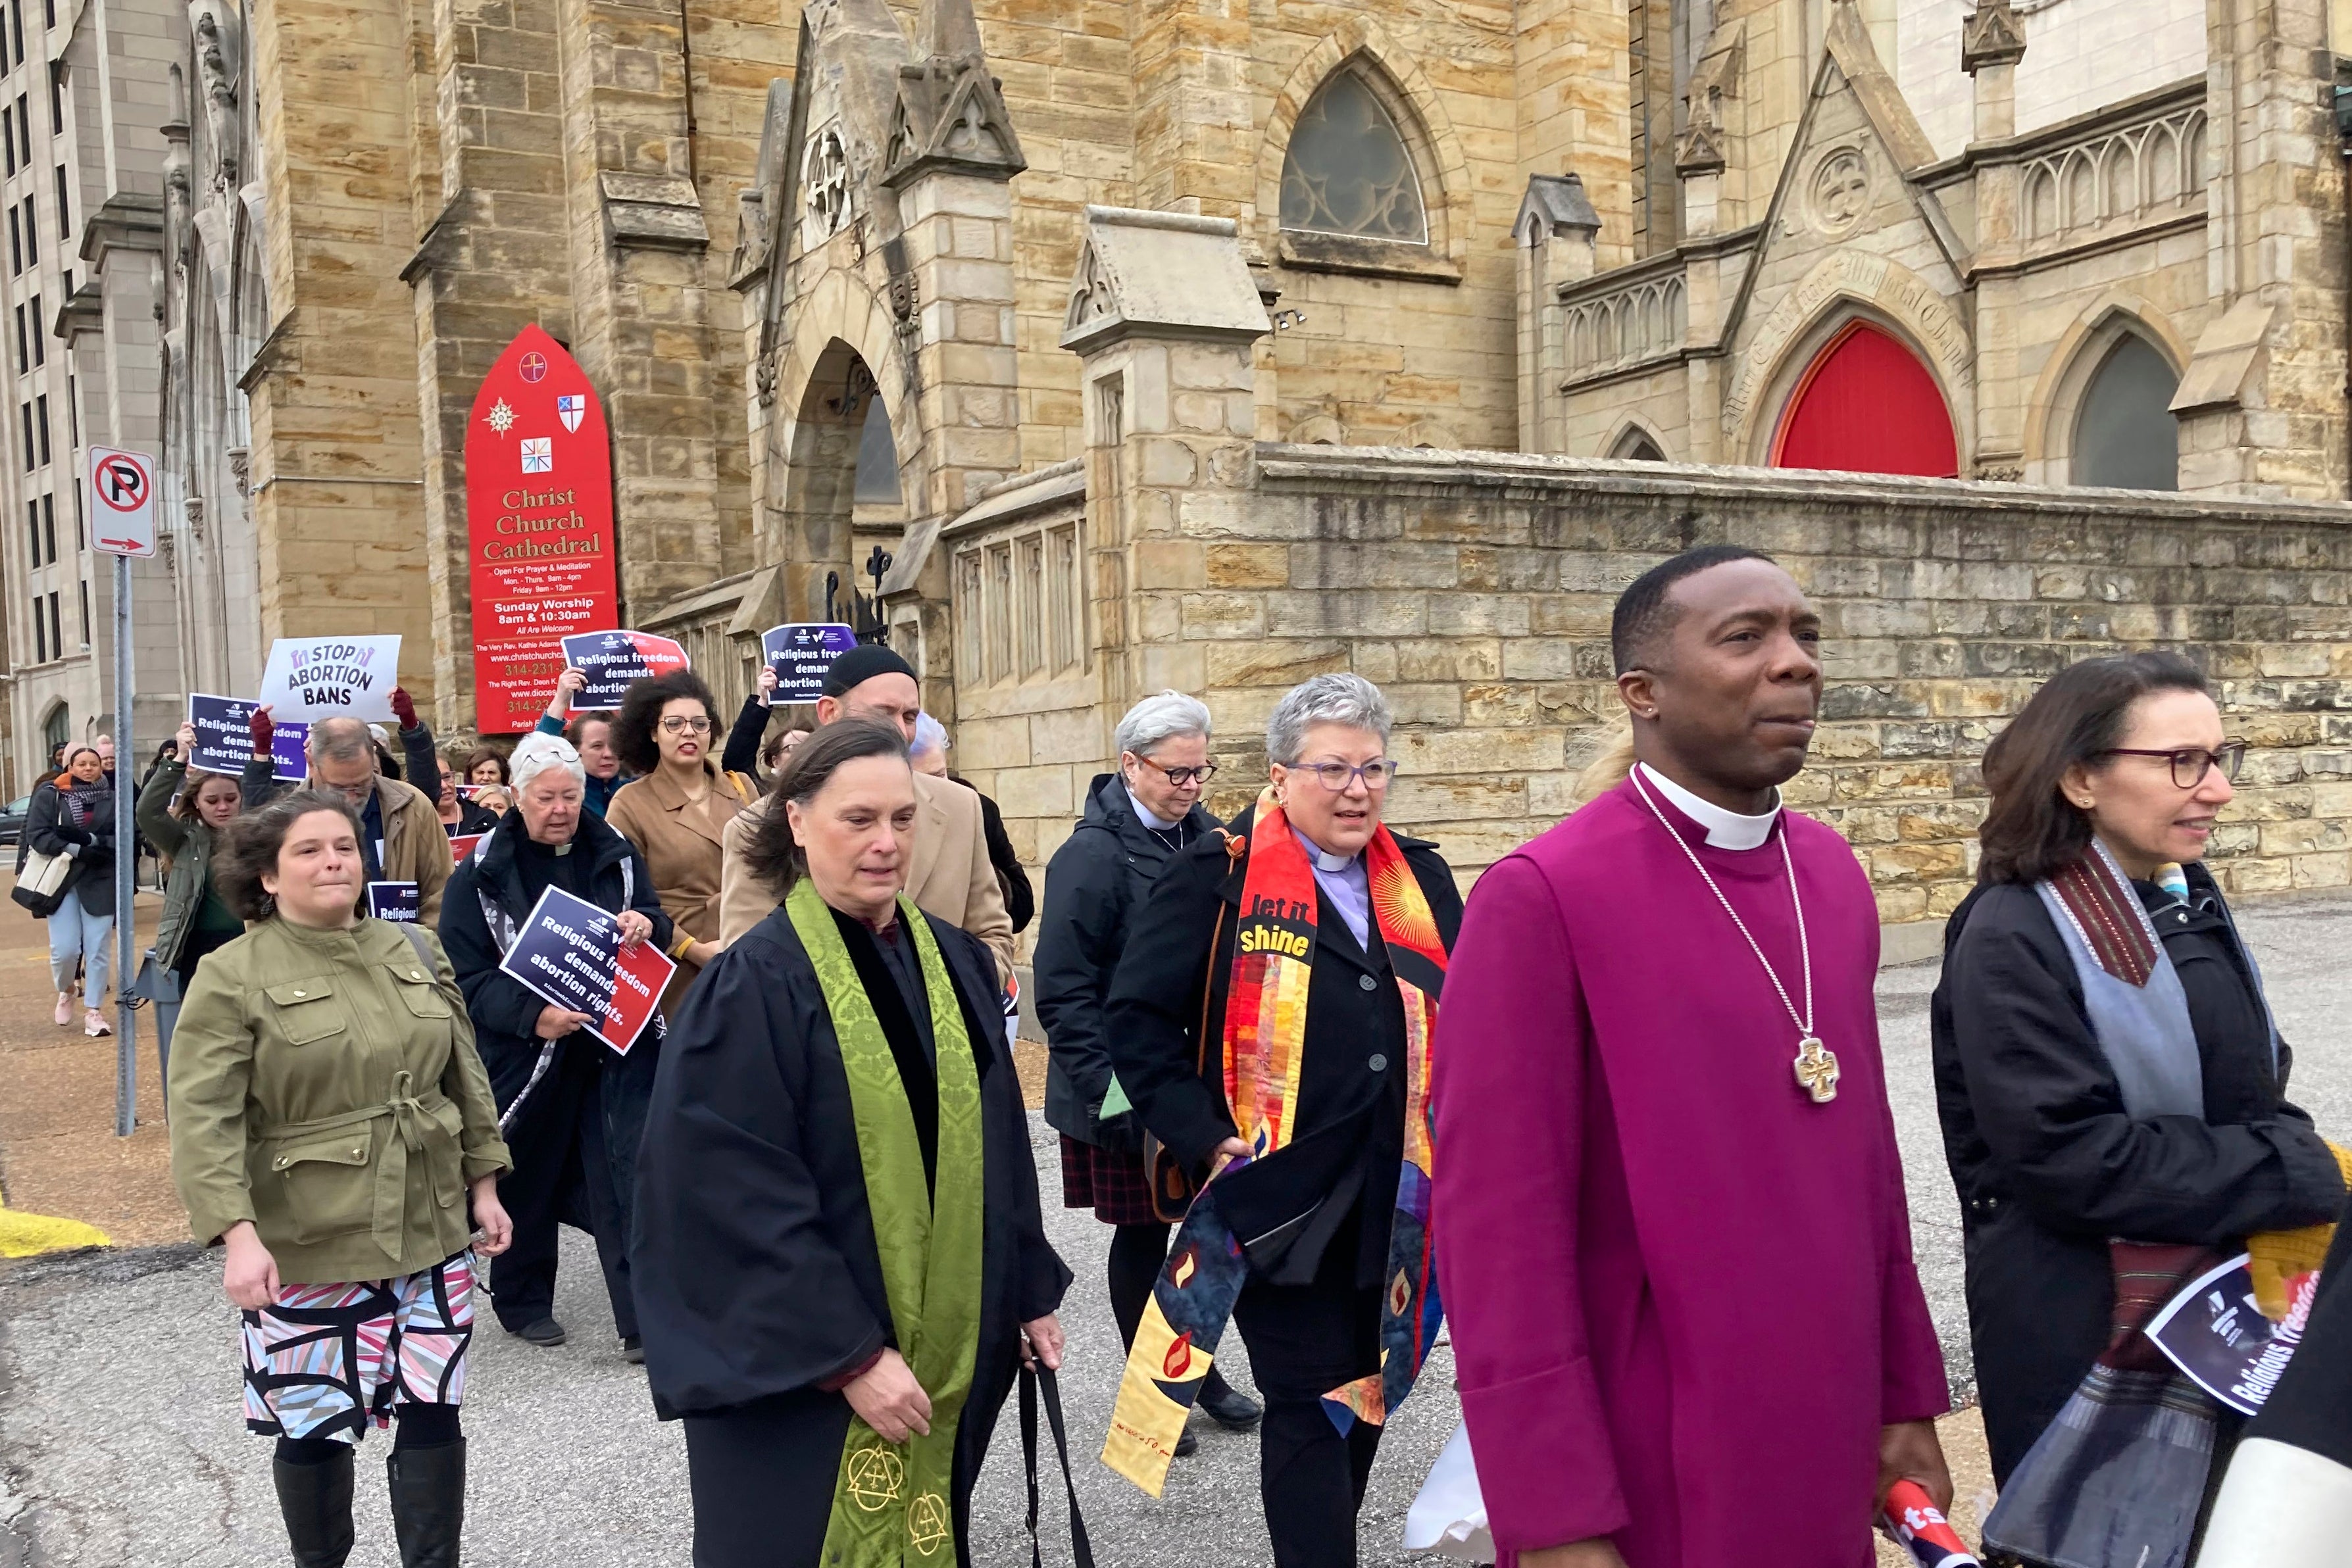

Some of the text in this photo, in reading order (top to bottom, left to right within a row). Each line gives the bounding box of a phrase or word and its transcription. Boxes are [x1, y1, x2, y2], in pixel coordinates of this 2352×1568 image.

[502, 487, 576, 510] Christ
[495, 510, 585, 535] Church
[483, 533, 600, 560] Cathedral
[493, 568, 512, 576] Open
[526, 565, 548, 575] Prayer
[557, 562, 591, 572] Meditation
[525, 576, 545, 584] Thurs.
[567, 574, 581, 582] 4pm
[513, 587, 532, 595] Friday
[494, 598, 593, 613] Sunday Worship
[499, 610, 590, 624] 8am & 10:30am
[516, 626, 526, 635] All
[541, 624, 574, 633] Welcome
[312, 644, 356, 662] STOP
[576, 652, 680, 666] Religious freedom
[770, 649, 818, 661] Religious
[288, 664, 373, 691] ABORTION
[605, 667, 655, 679] demands
[501, 679, 517, 688] Right
[778, 677, 822, 688] abortion
[303, 686, 351, 706] BANS
[198, 717, 251, 733] Religious
[202, 747, 251, 761] abortion
[380, 907, 416, 921] Religious
[1251, 894, 1310, 921] let it
[1240, 924, 1309, 957] shine
[541, 915, 607, 962] Religious
[605, 956, 651, 998] freedom
[564, 951, 619, 996] demands
[530, 953, 624, 1026] abortion rights.
